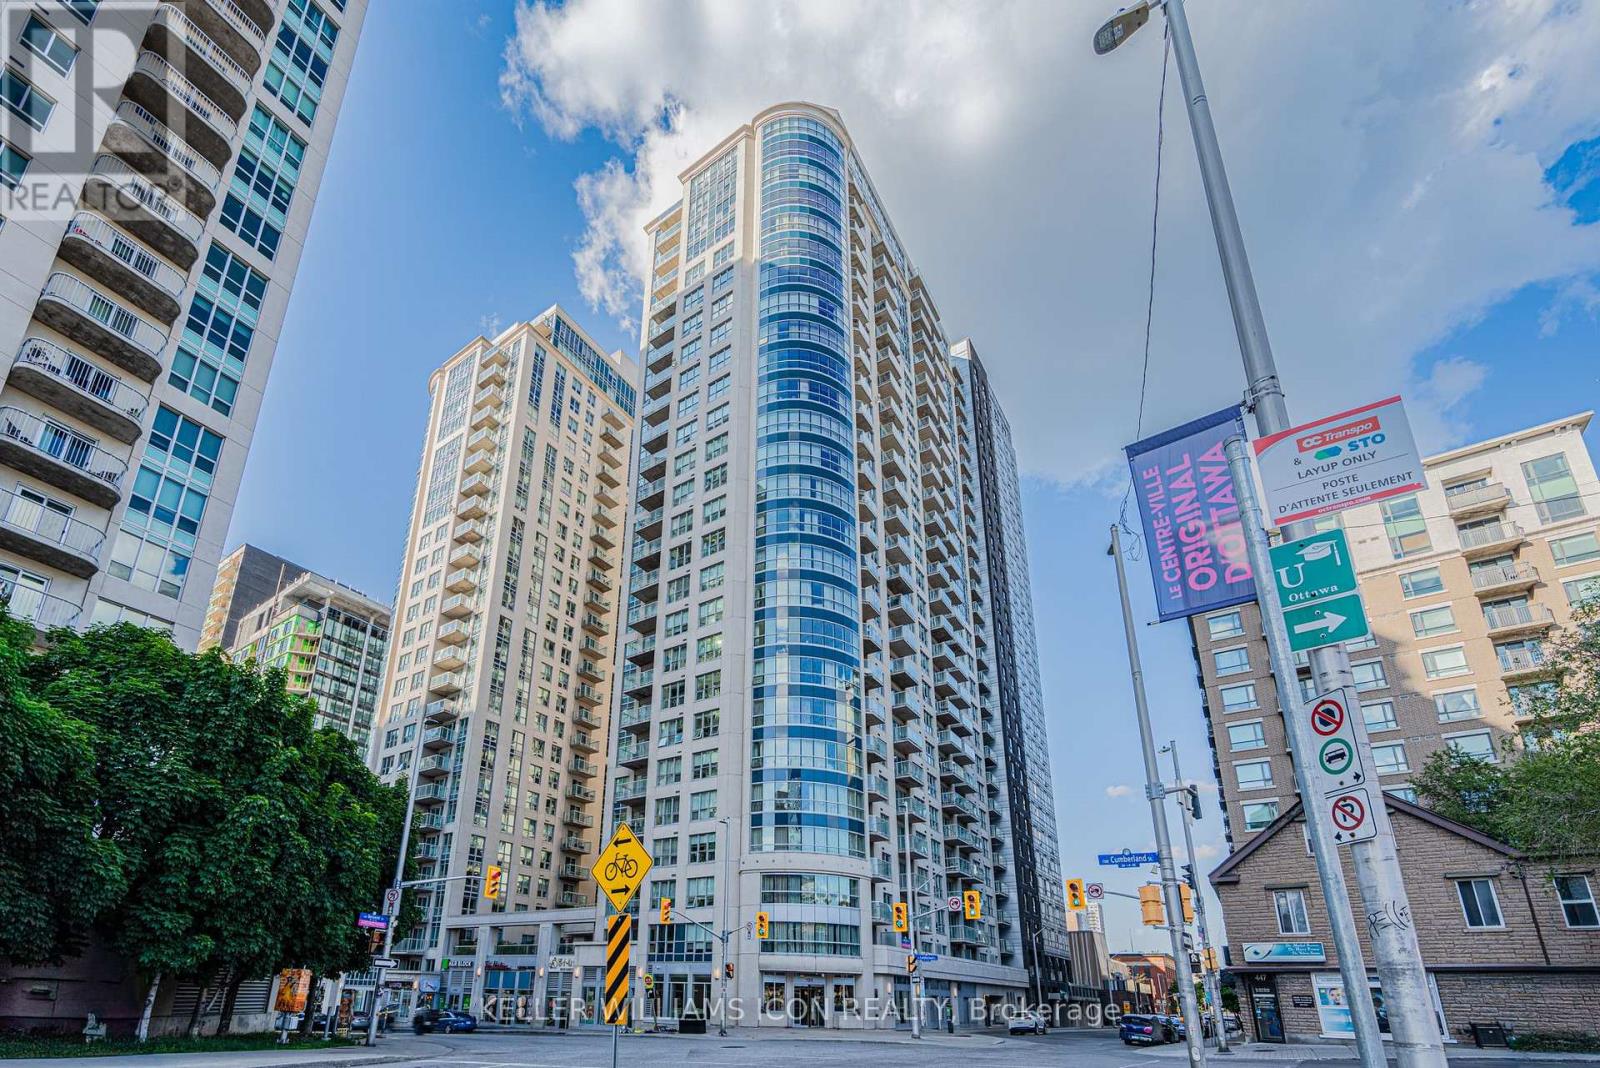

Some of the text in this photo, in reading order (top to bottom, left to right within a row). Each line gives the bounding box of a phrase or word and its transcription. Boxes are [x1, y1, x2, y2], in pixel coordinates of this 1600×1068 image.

[1324, 422, 1374, 442] Transpo
[1348, 433, 1386, 451] STO
[1293, 457, 1302, 466] &
[1298, 450, 1377, 480] LAYUP ONLY
[1322, 473, 1360, 490] POSTE
[1278, 471, 1414, 514] D'ATTENTE SEULEMENT
[1143, 464, 1184, 600] LE CENTRE-VILLE
[1166, 453, 1218, 591] ORIGINAL
[1276, 562, 1304, 588] U
[1288, 585, 1339, 602] Ottawa
[1110, 854, 1147, 864] Cumberland
